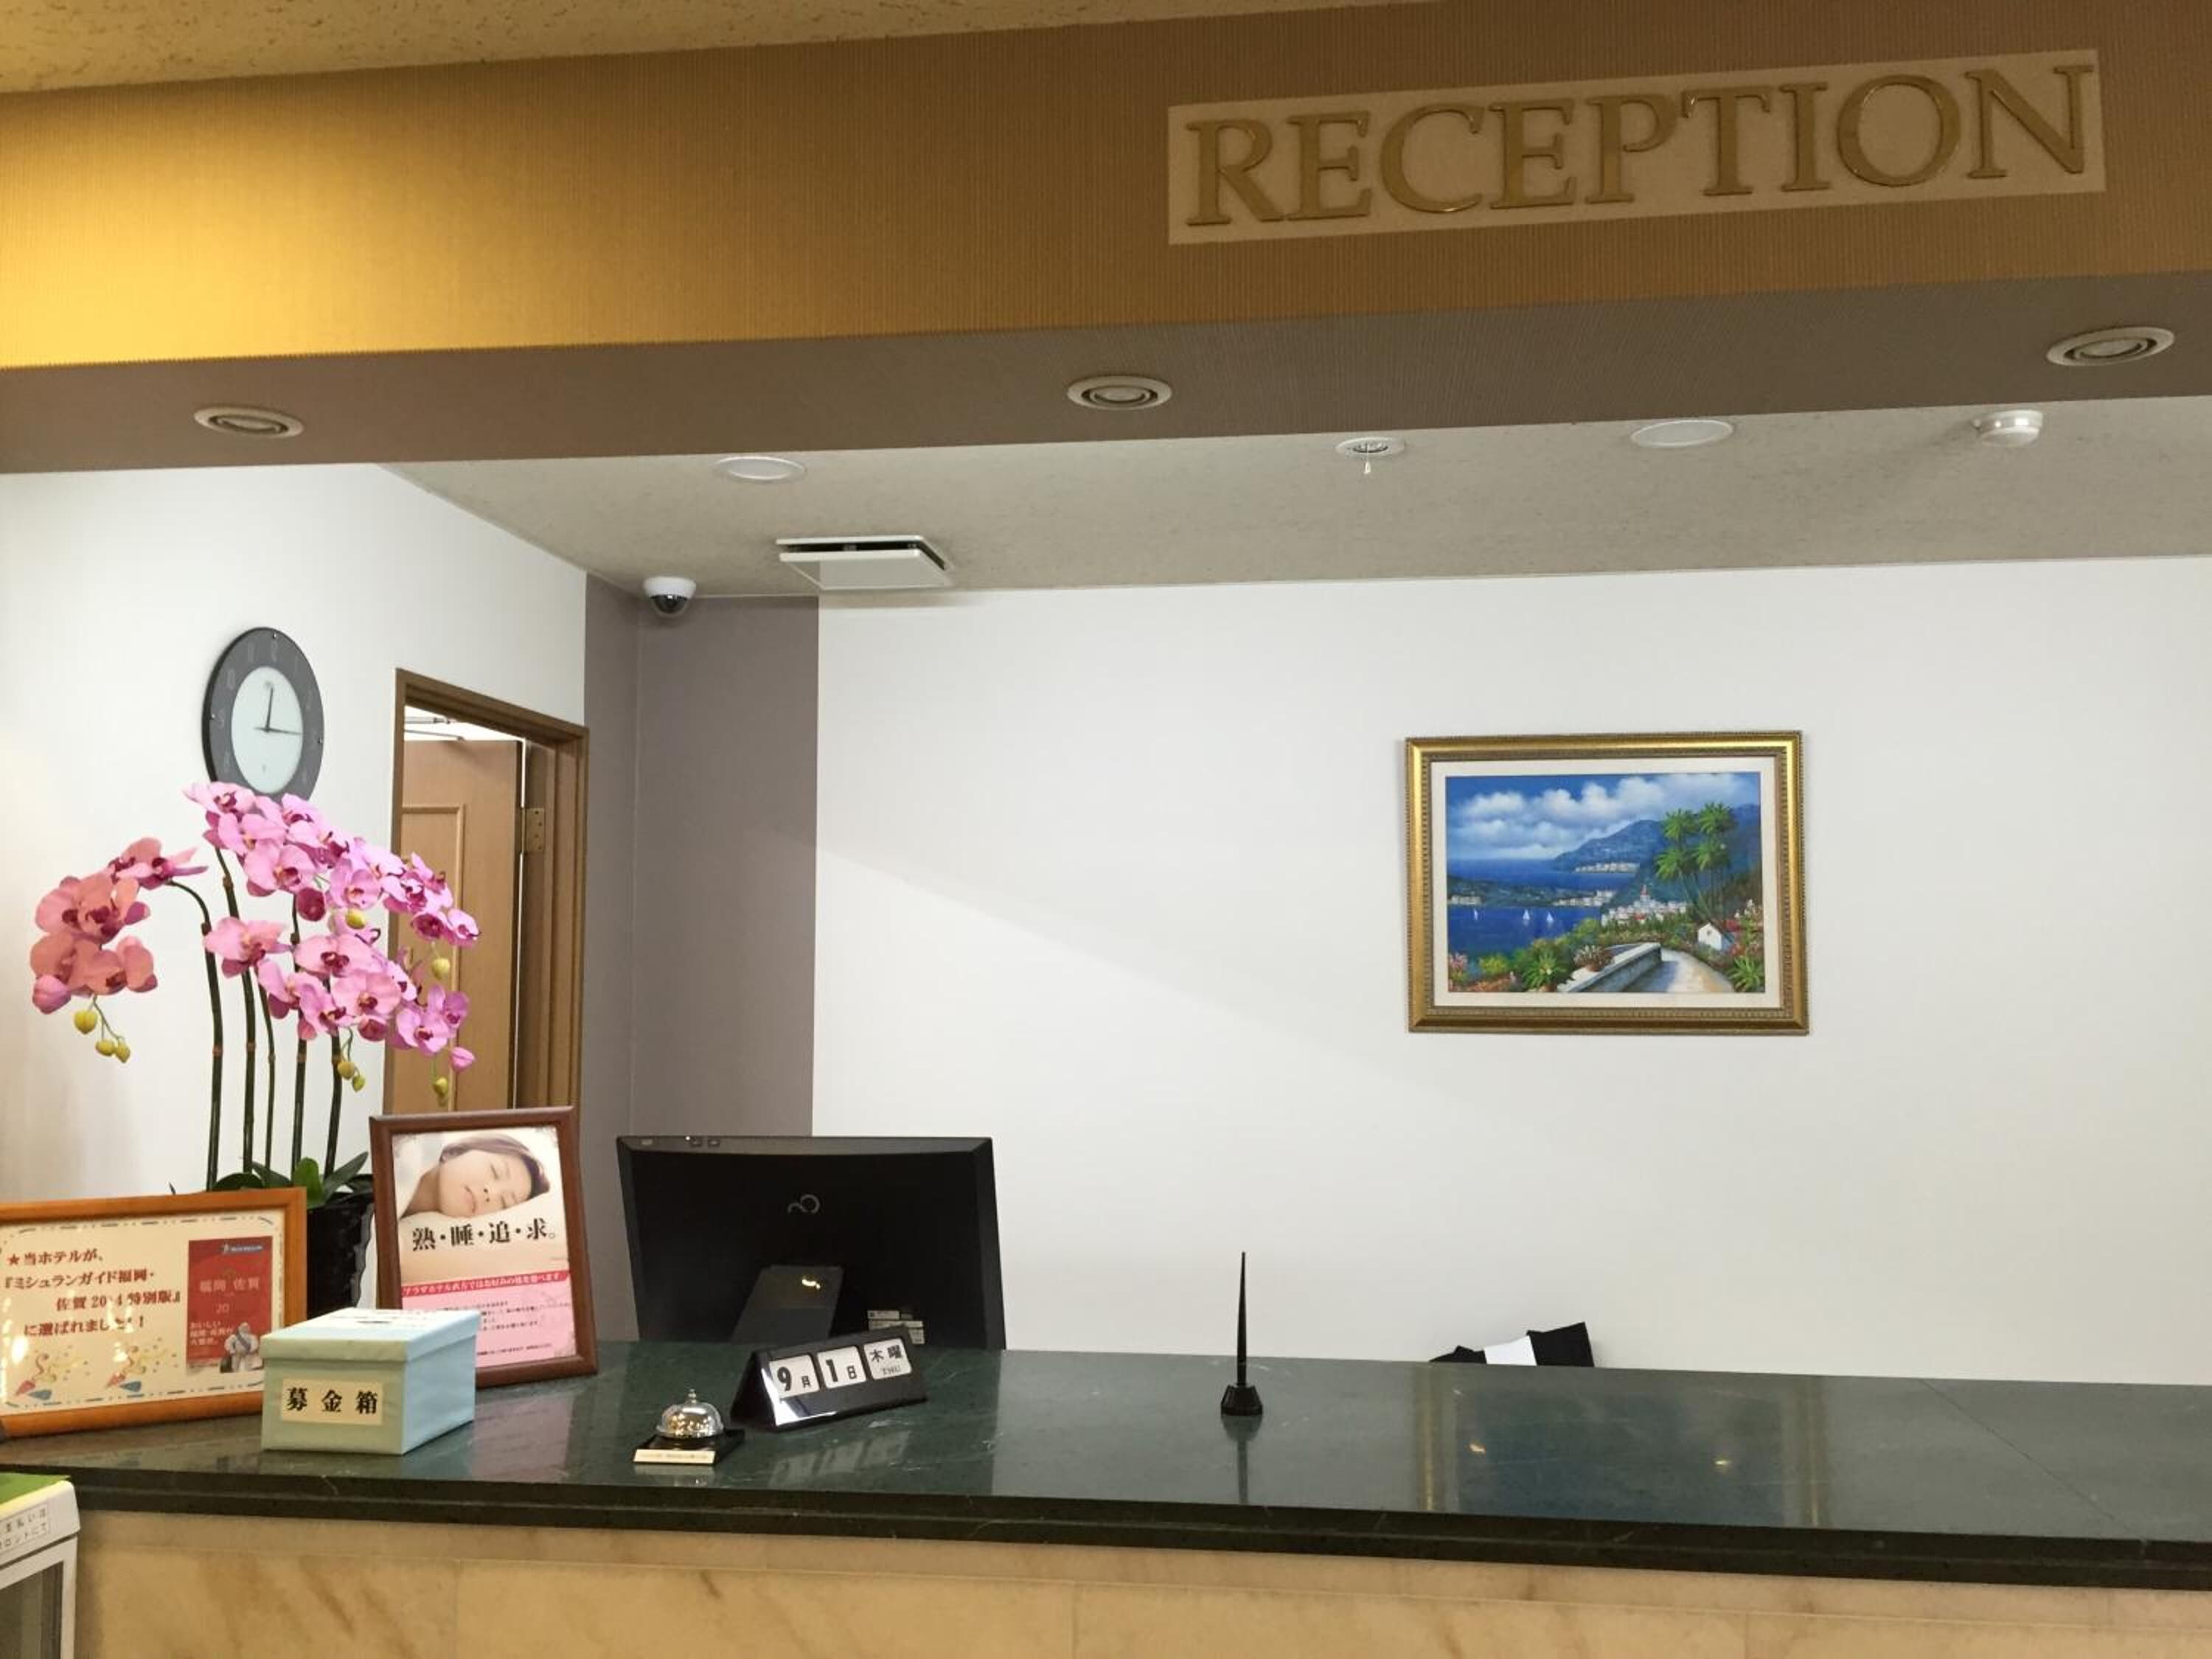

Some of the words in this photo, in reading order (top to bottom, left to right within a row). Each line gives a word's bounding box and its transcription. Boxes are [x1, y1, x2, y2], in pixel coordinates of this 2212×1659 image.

[1185, 63, 2095, 226] RECEPTION
[411, 1217, 556, 1251] 熟・睡・追・求。
[869, 1345, 902, 1363] 木曜
[287, 1387, 378, 1415] 募金箱
